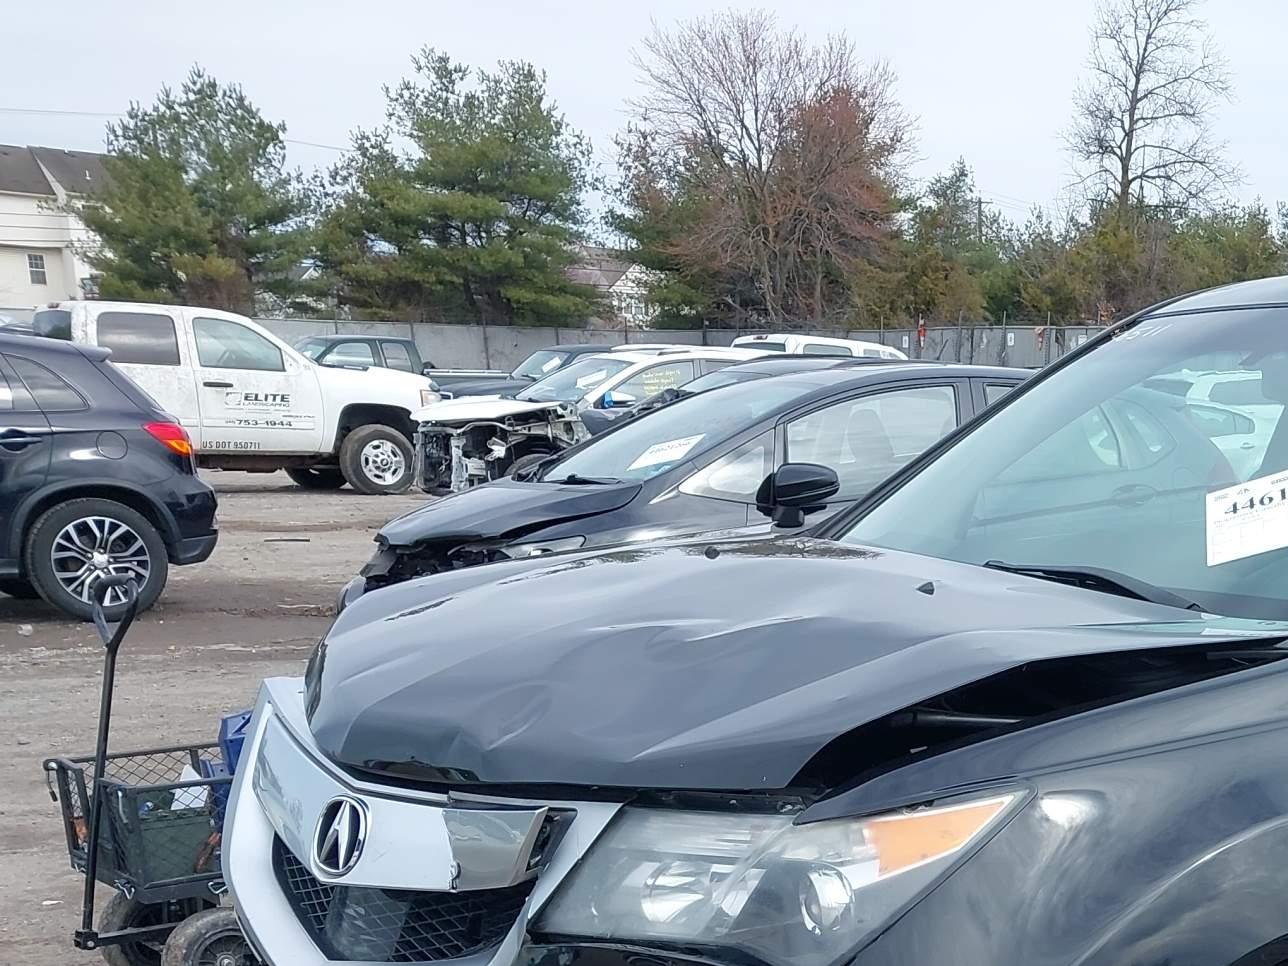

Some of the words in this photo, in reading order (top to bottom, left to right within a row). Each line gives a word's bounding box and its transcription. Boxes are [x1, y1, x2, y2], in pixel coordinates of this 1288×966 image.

[243, 392, 291, 402] ELITE
[202, 441, 214, 449] US
[215, 441, 232, 449] DOT
[233, 441, 261, 449] 950711
